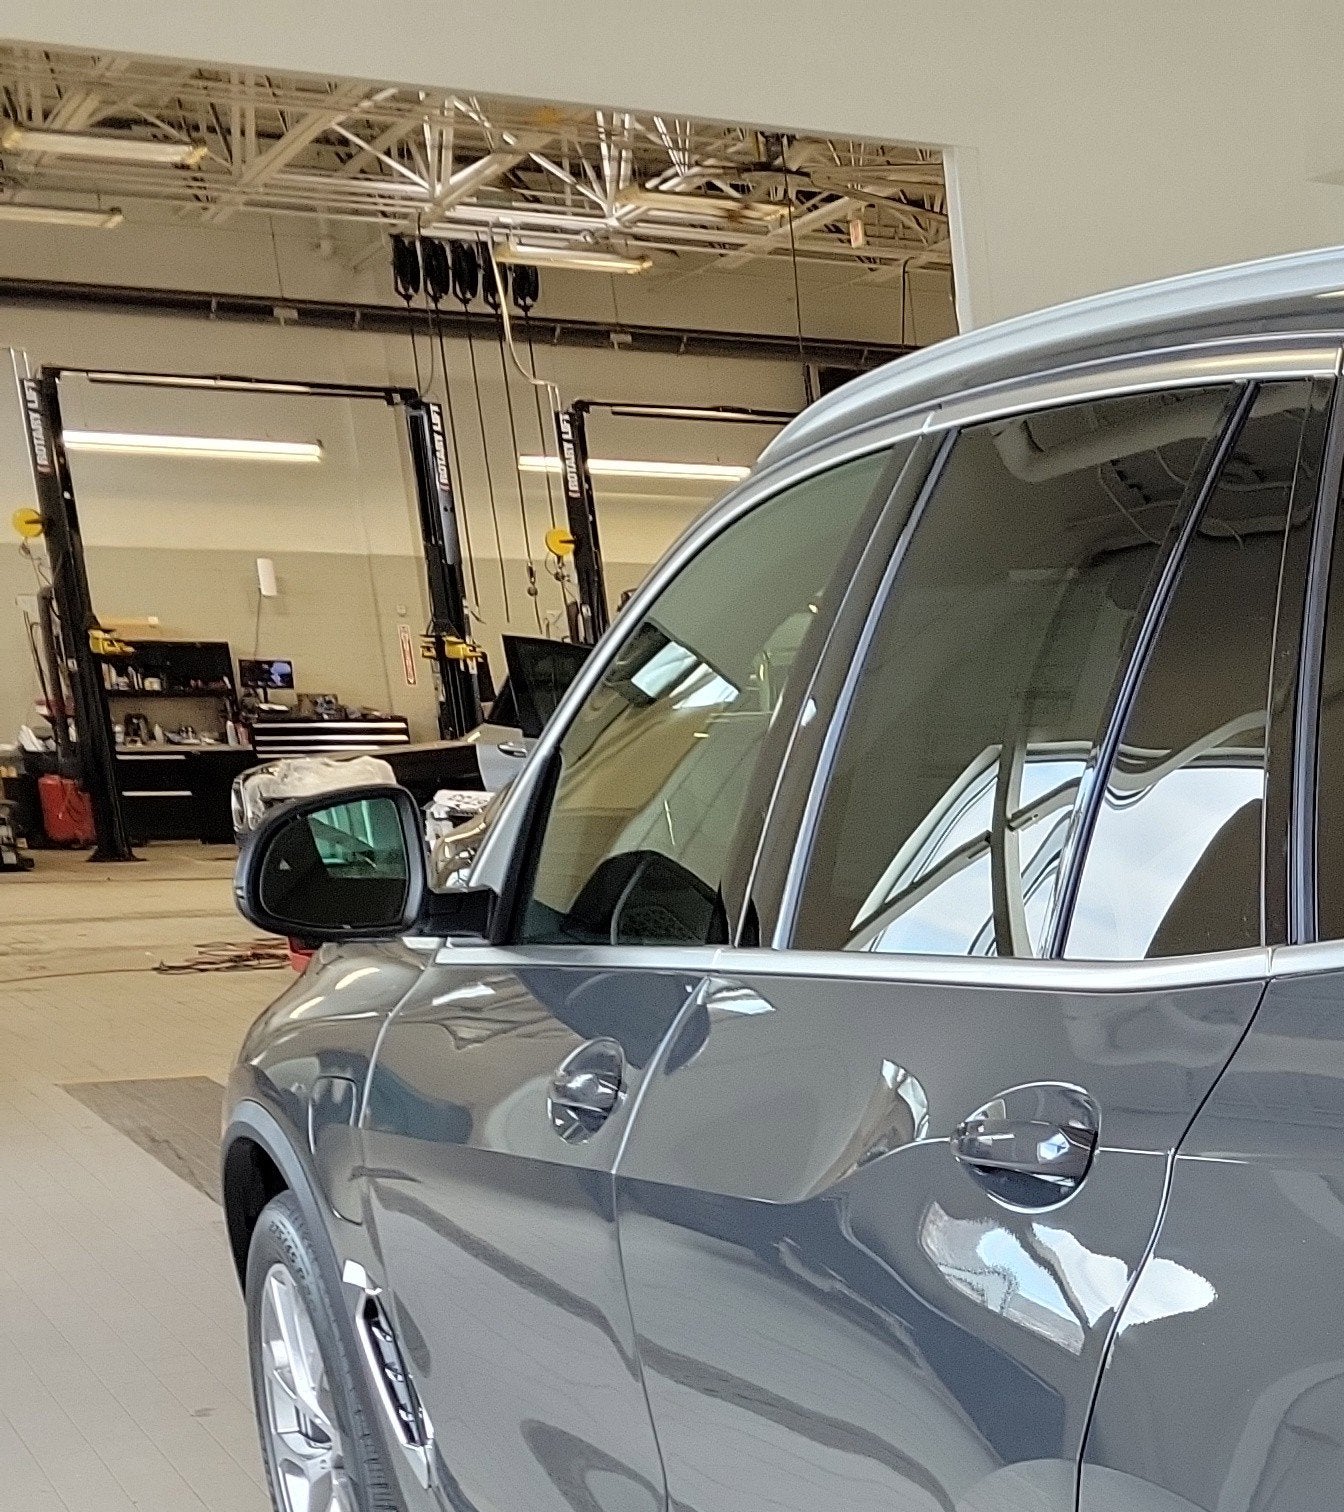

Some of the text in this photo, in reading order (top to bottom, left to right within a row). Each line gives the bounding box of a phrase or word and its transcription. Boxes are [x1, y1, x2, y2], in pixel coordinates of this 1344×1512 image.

[23, 379, 48, 465] ROTARY LIFT
[560, 412, 579, 491] ROTARY LIFT
